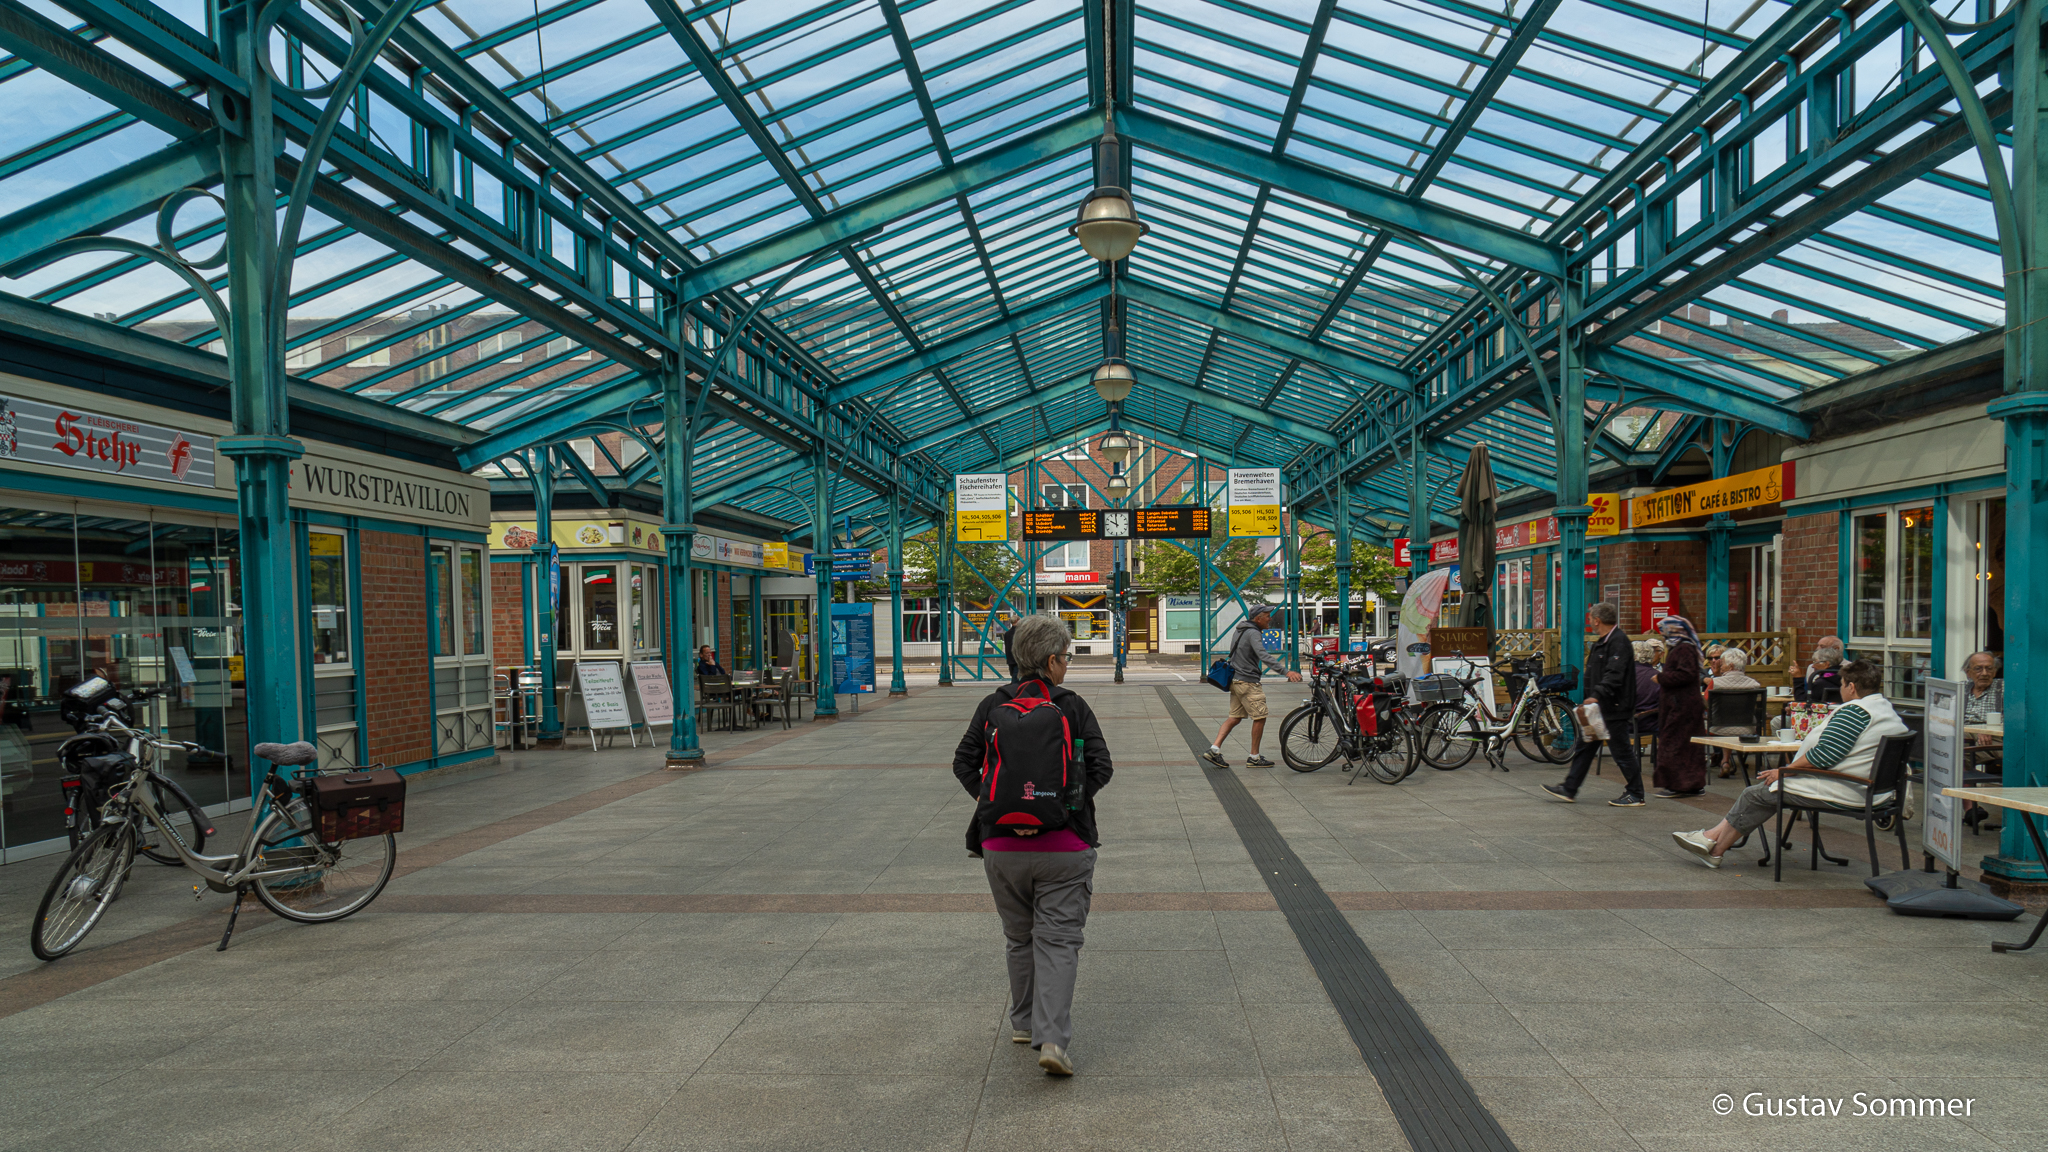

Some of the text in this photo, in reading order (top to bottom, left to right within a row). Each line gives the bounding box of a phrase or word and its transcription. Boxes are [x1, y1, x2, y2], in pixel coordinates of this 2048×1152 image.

[87, 416, 140, 434] FLEISCHEREI
[52, 410, 142, 473] Stehr
[303, 463, 470, 517] WURSTPAVILLON
[1700, 485, 1761, 510] CAFÉ & BISTRO
[1168, 597, 1193, 606] Nissen
[1032, 790, 1057, 798] Langeoog
[159, 816, 187, 848] Gazelle
